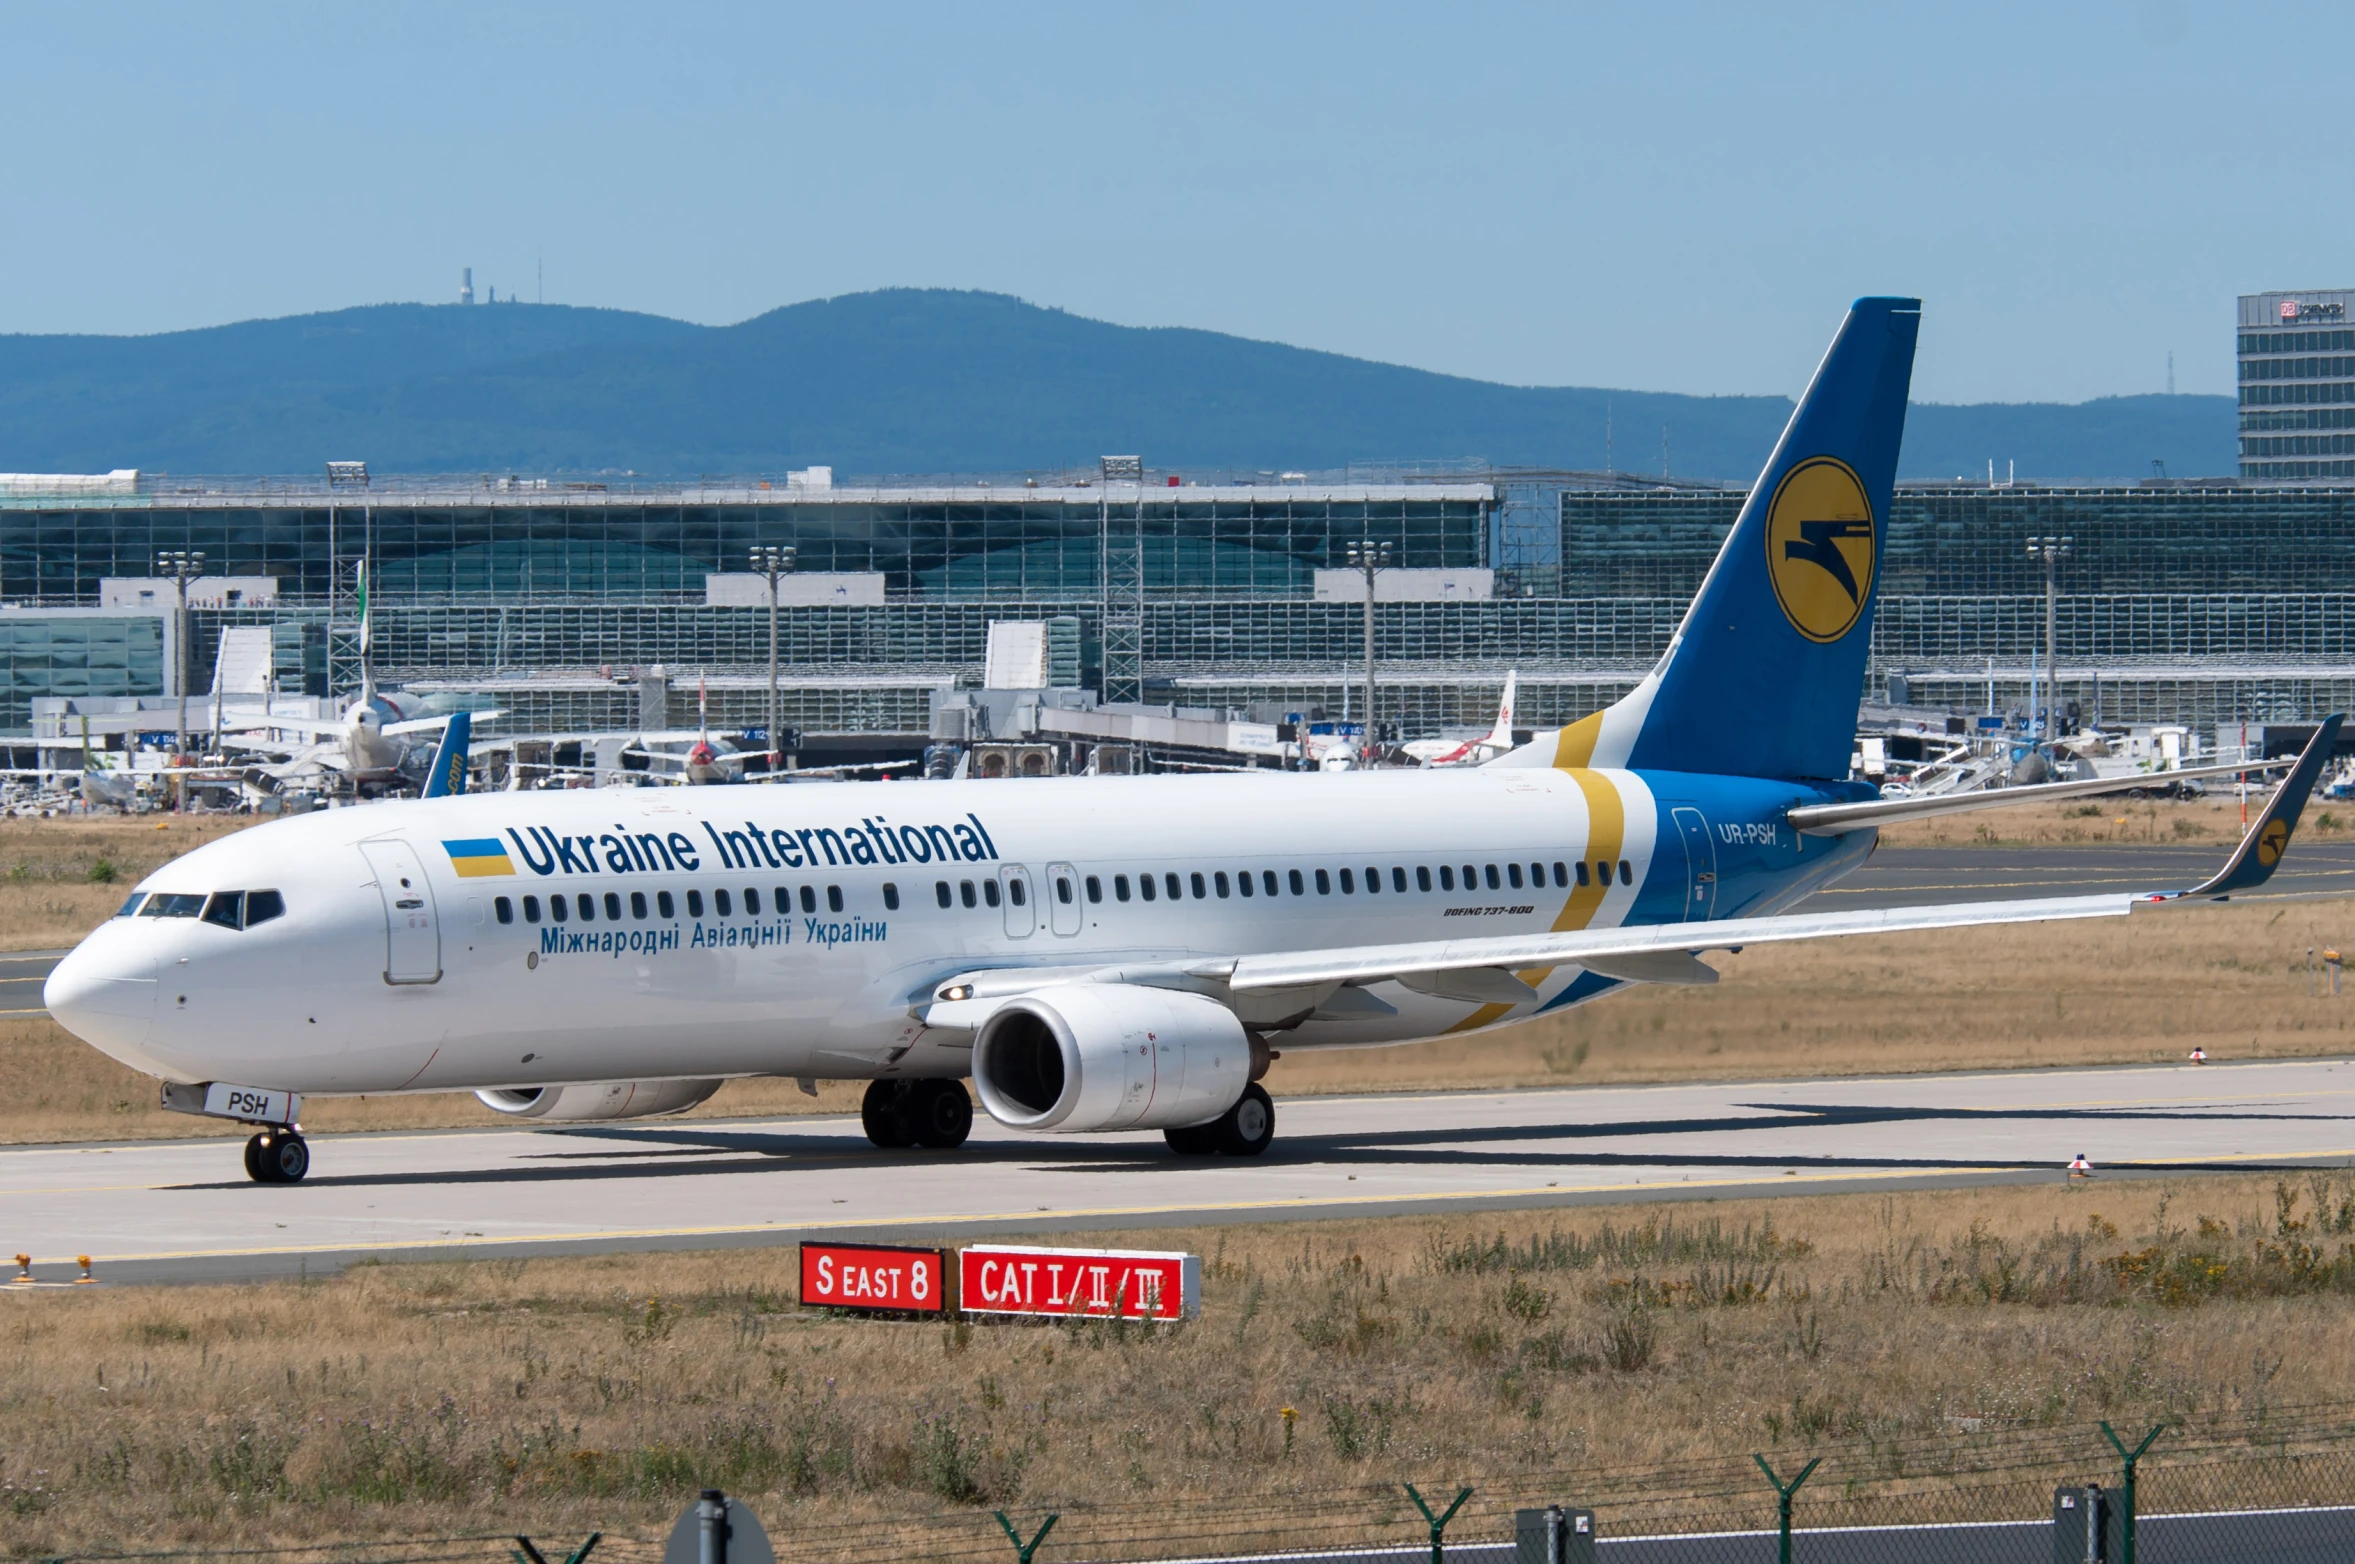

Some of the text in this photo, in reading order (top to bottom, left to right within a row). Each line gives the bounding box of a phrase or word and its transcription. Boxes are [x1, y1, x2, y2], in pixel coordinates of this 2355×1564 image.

[505, 812, 999, 876] Ukraine International
[1717, 823, 1776, 846] UR-PSH
[1443, 905, 1535, 917] BOEING 737-800
[540, 915, 887, 958] Міжнародні Авіалінії України
[227, 1091, 270, 1116] PSH
[815, 1255, 928, 1300] S EAST 8
[980, 1260, 1038, 1304] CAT
